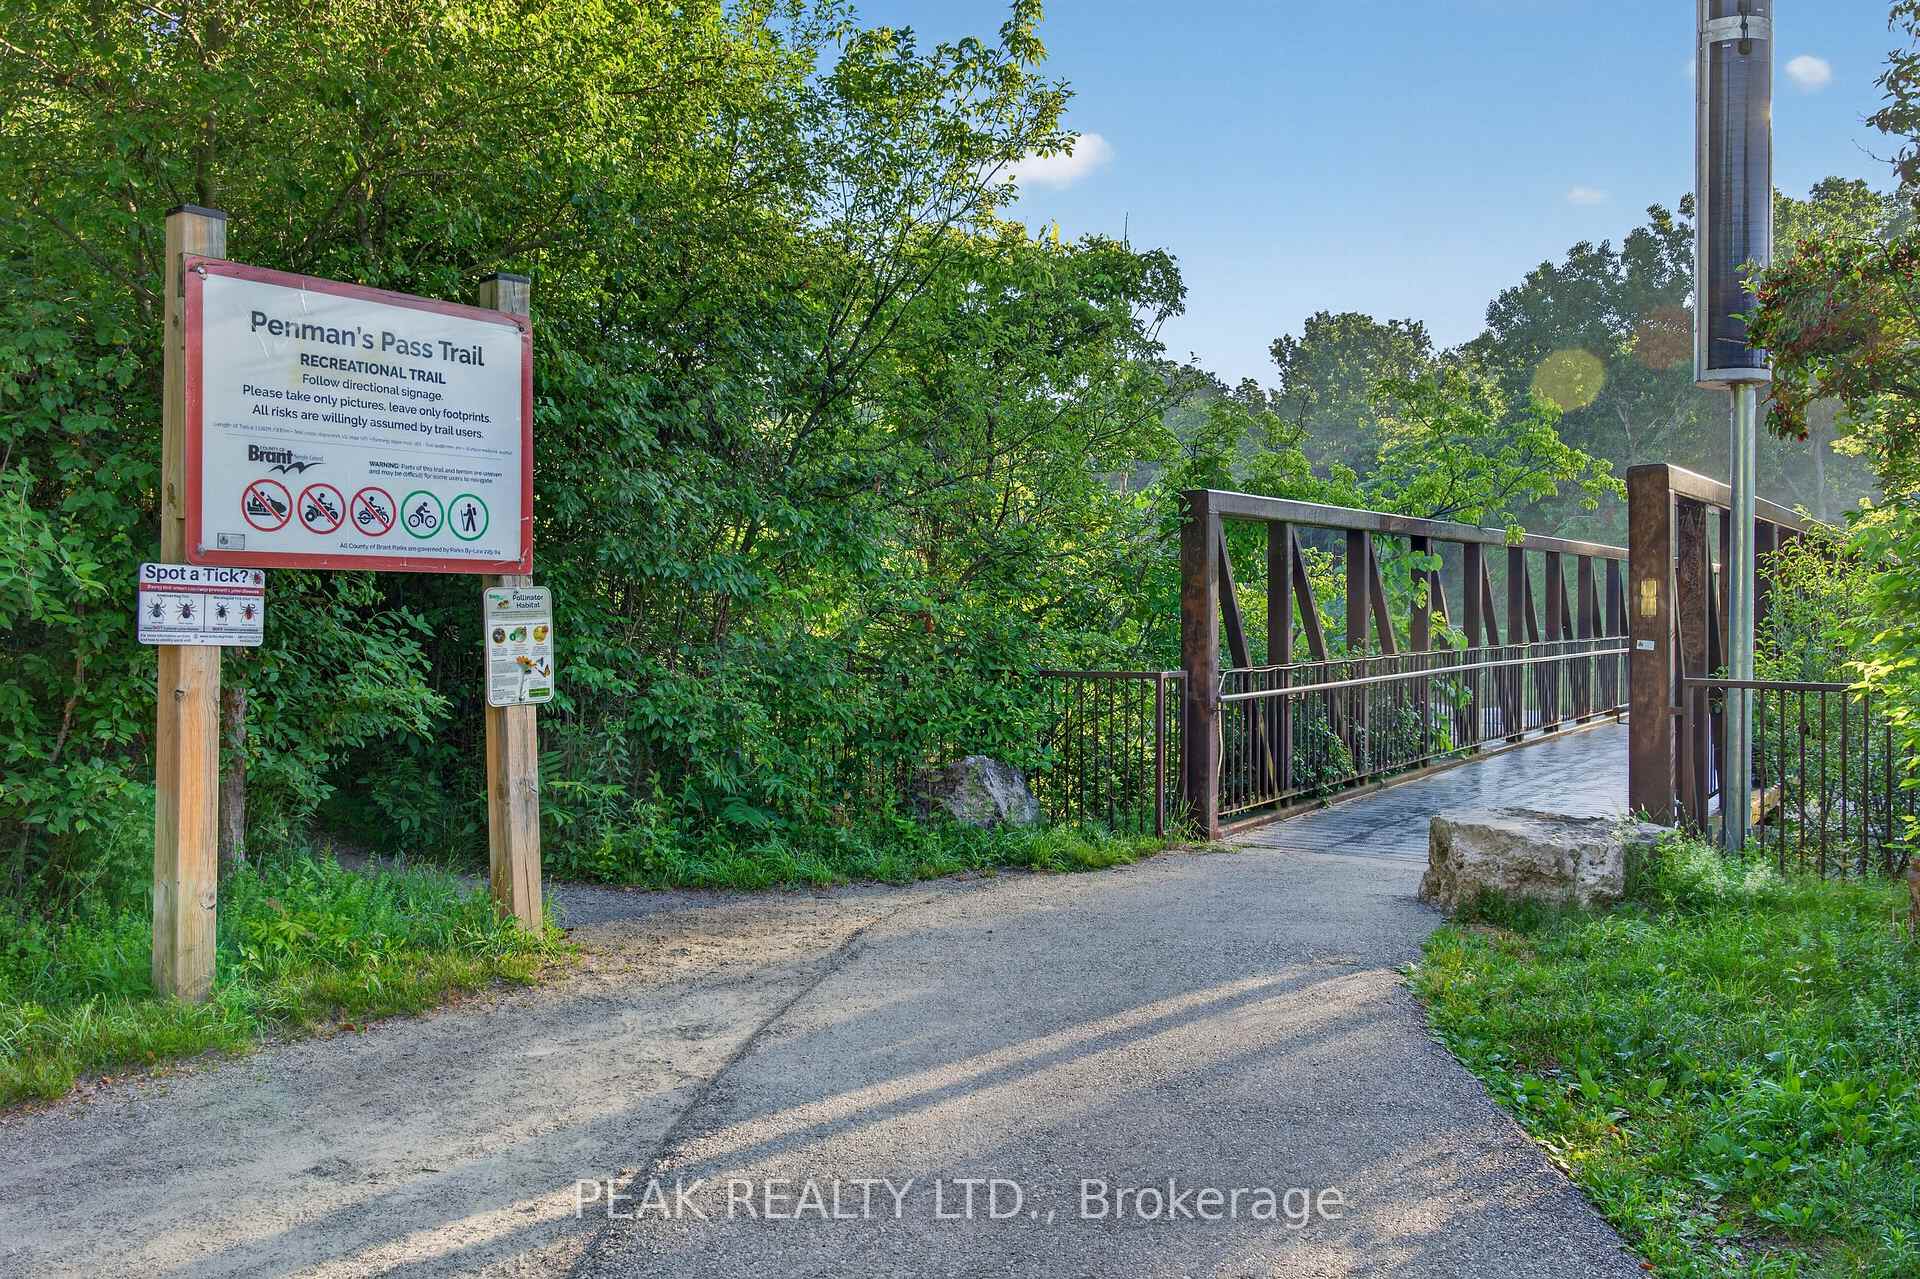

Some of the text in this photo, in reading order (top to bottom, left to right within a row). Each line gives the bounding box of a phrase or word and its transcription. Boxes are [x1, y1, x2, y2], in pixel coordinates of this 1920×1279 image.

[251, 310, 485, 366] Penman's Pass Trail
[300, 353, 447, 385] RECREATIONAL TRAIL
[302, 374, 444, 402] Follow directional signage.
[243, 384, 283, 399] Please
[285, 390, 311, 402] take
[313, 394, 338, 408] only
[389, 402, 417, 415] leave
[419, 406, 441, 420] only
[443, 408, 492, 424] footprints.
[252, 404, 484, 439] All risks are willingly assumed by trail users.
[248, 444, 293, 464] Brant
[349, 543, 368, 551] County
[145, 564, 249, 583] Spot a Tick?
